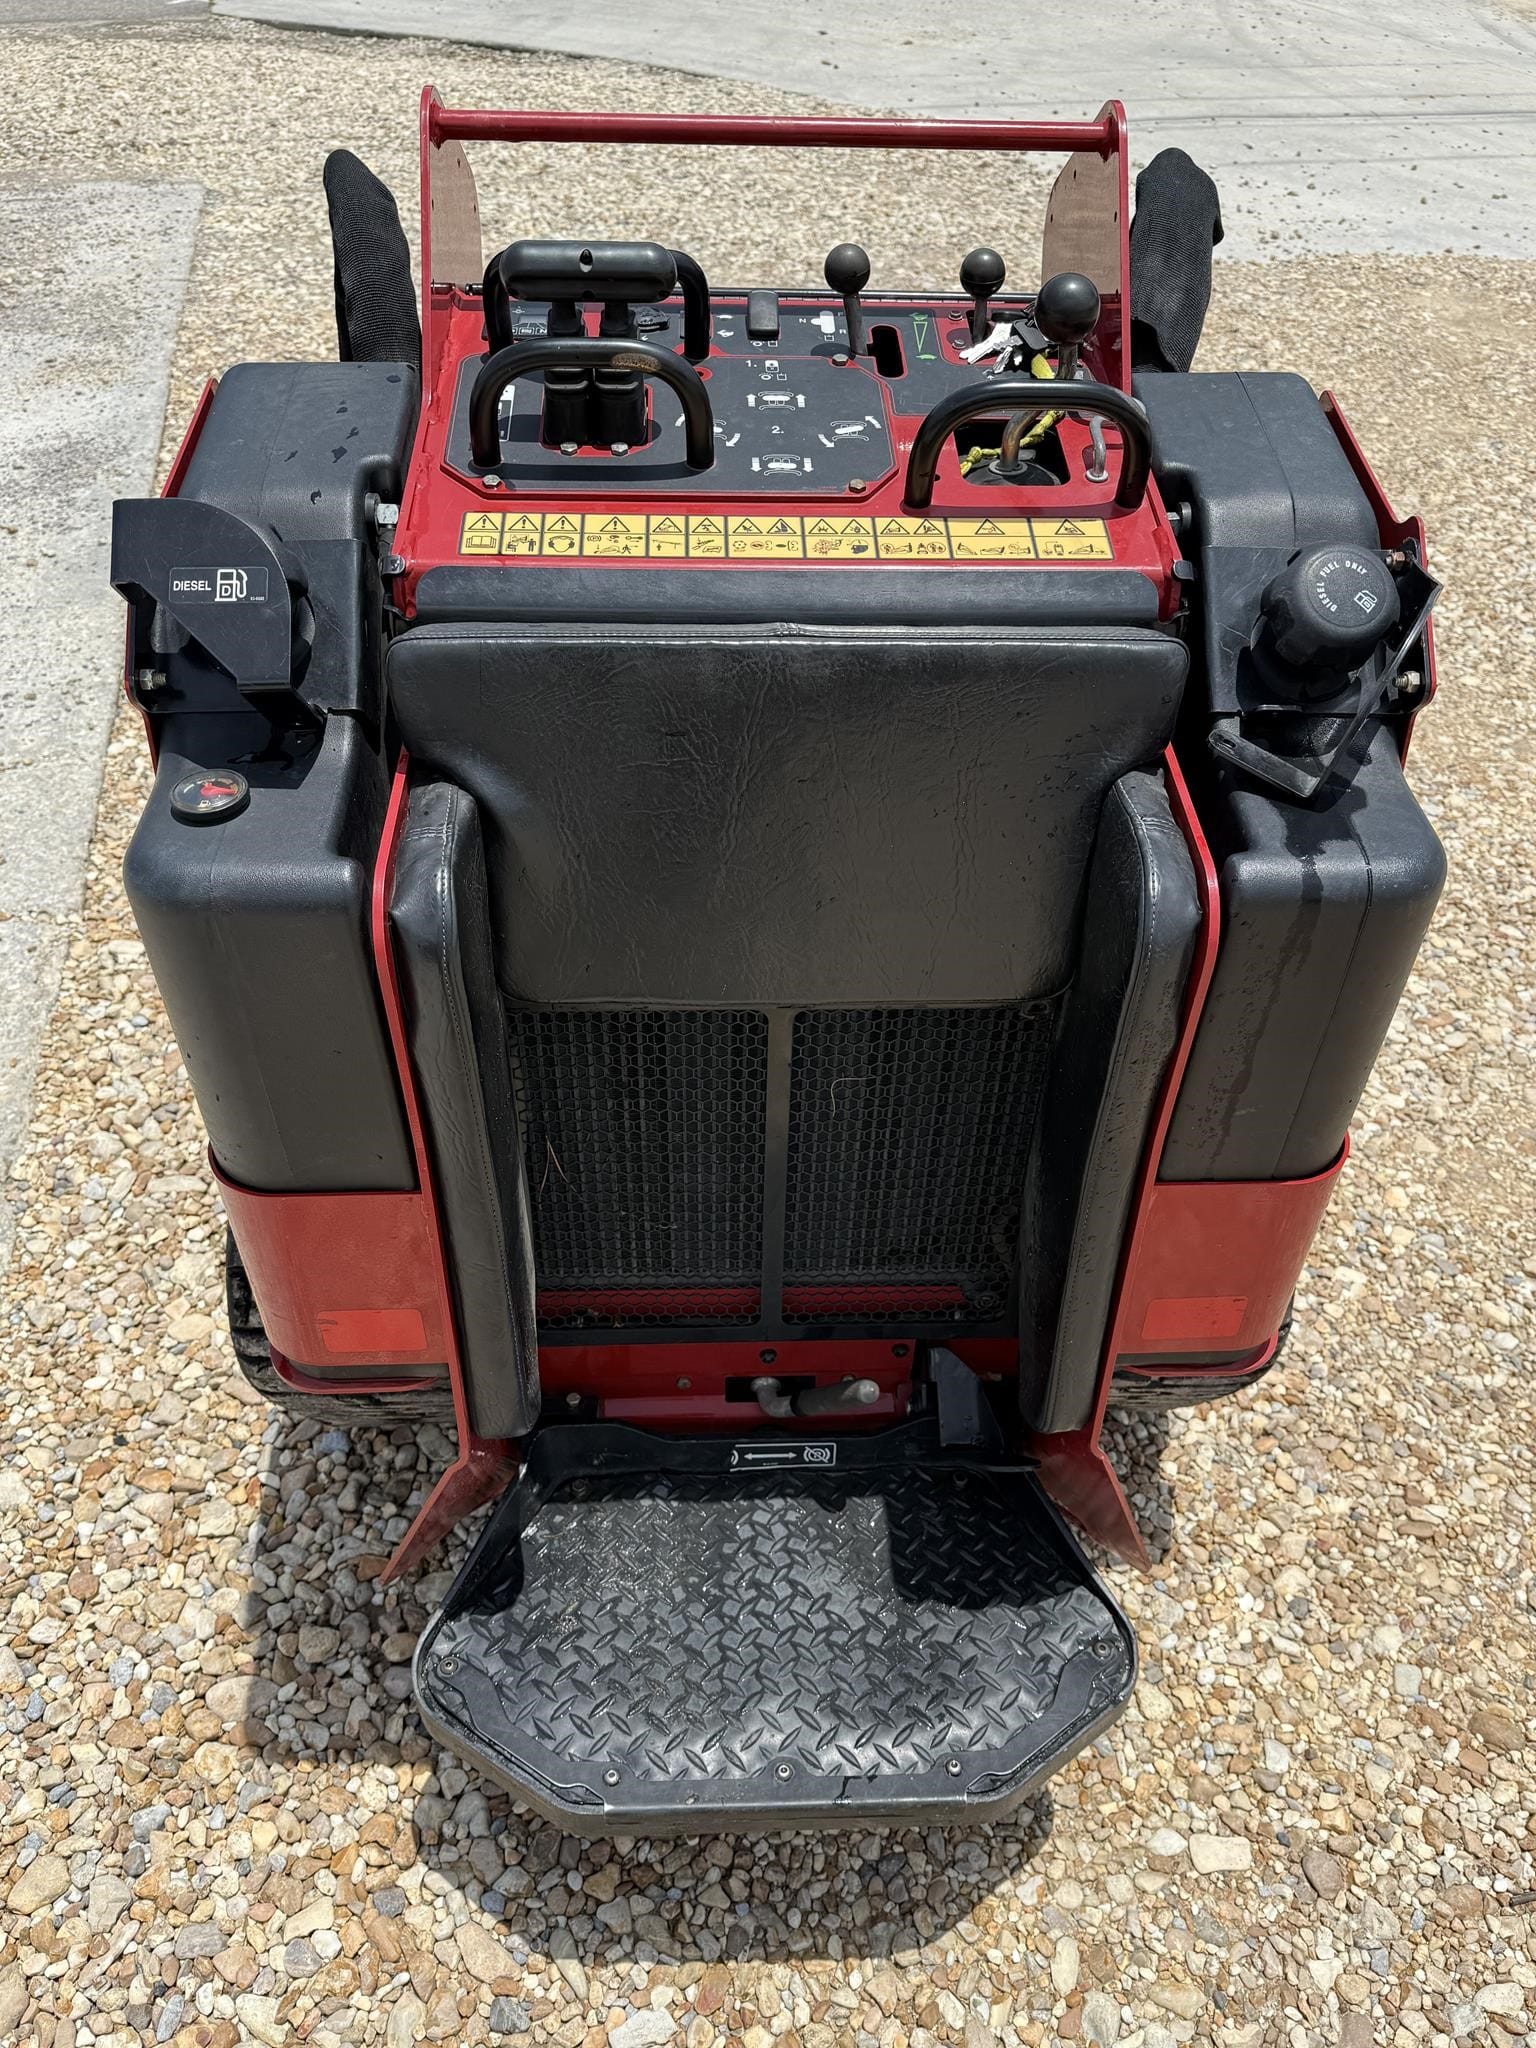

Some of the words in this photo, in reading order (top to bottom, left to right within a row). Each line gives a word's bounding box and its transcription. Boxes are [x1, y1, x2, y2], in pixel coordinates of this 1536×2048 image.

[746, 359, 758, 368] 1.
[771, 425, 785, 434] 2.
[1320, 561, 1340, 577] FUEL
[1345, 560, 1368, 575] ONLY
[173, 580, 212, 591] DIESEL
[221, 585, 232, 596] D
[1316, 582, 1338, 612] DIESEL
